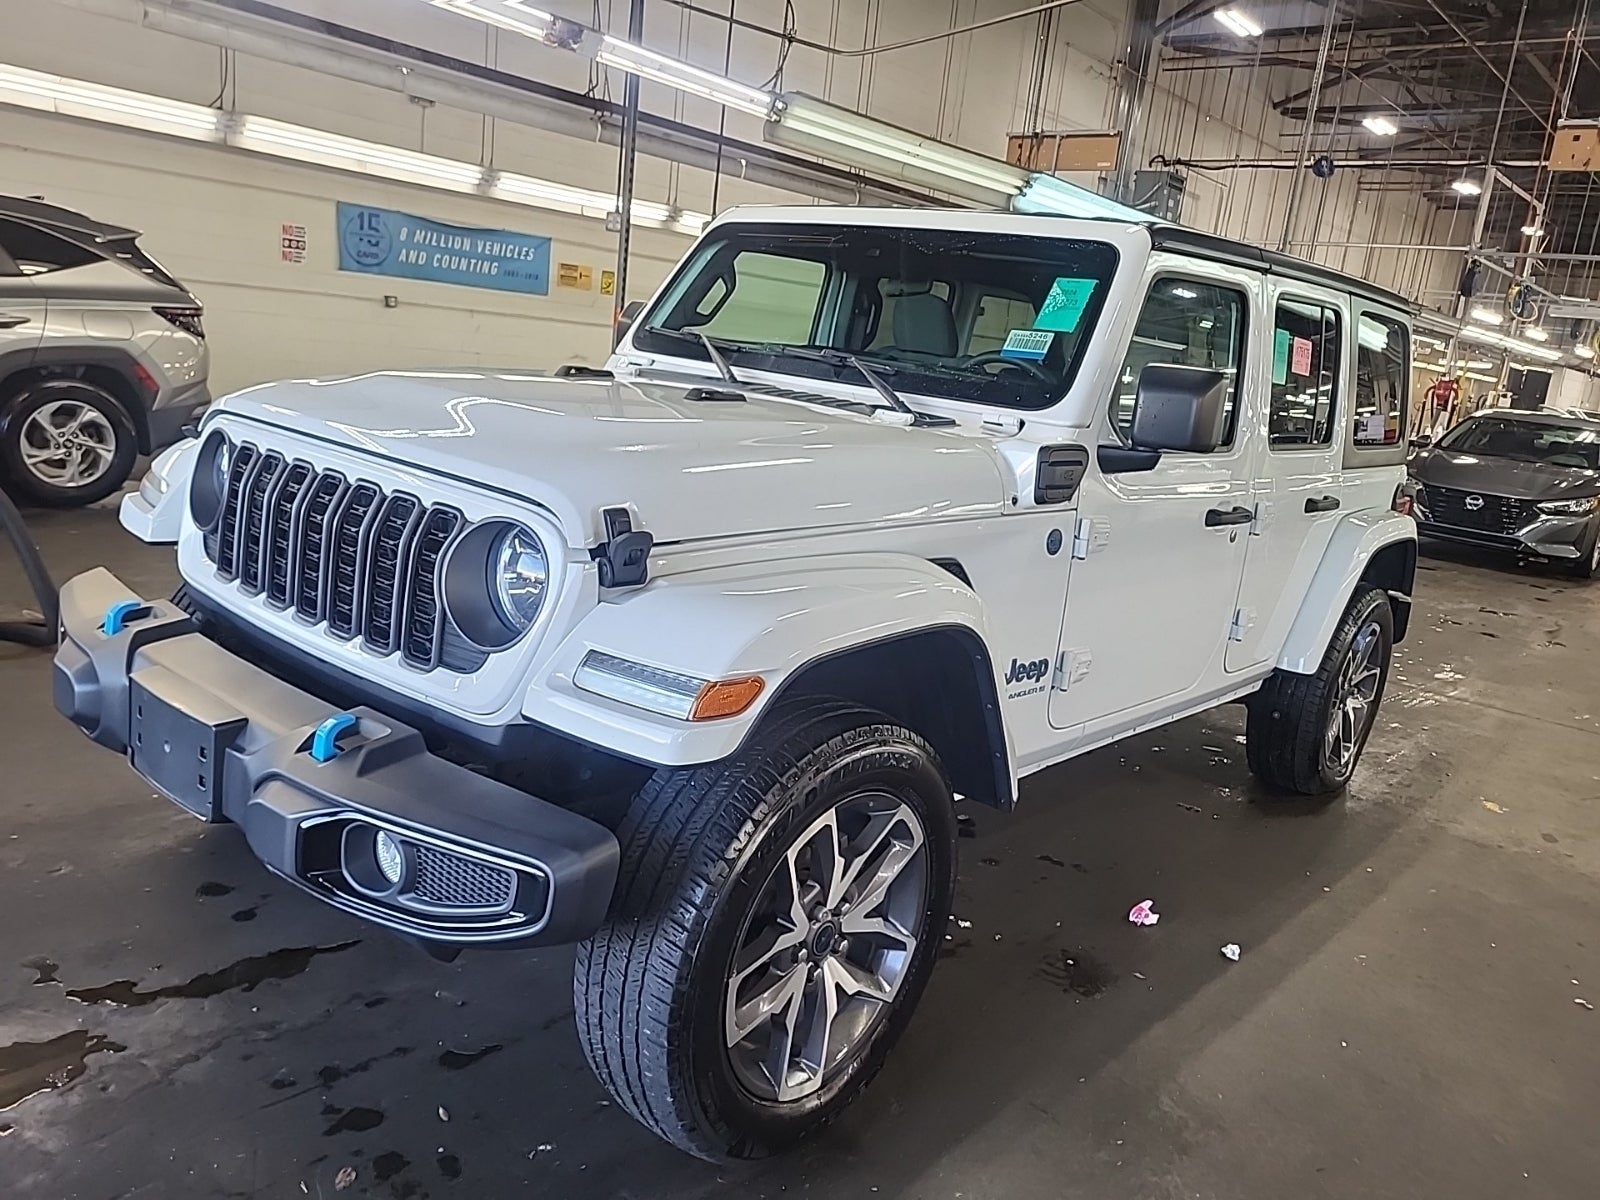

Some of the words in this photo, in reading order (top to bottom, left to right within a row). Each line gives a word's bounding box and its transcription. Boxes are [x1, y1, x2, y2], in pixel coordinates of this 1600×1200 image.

[282, 224, 294, 236] NO
[282, 250, 293, 263] NO
[414, 229, 471, 251] MILLION
[478, 239, 535, 261] VEHICLES
[399, 248, 427, 265] AND
[433, 253, 499, 276] COUNTING
[1004, 658, 1049, 686] Jeep
